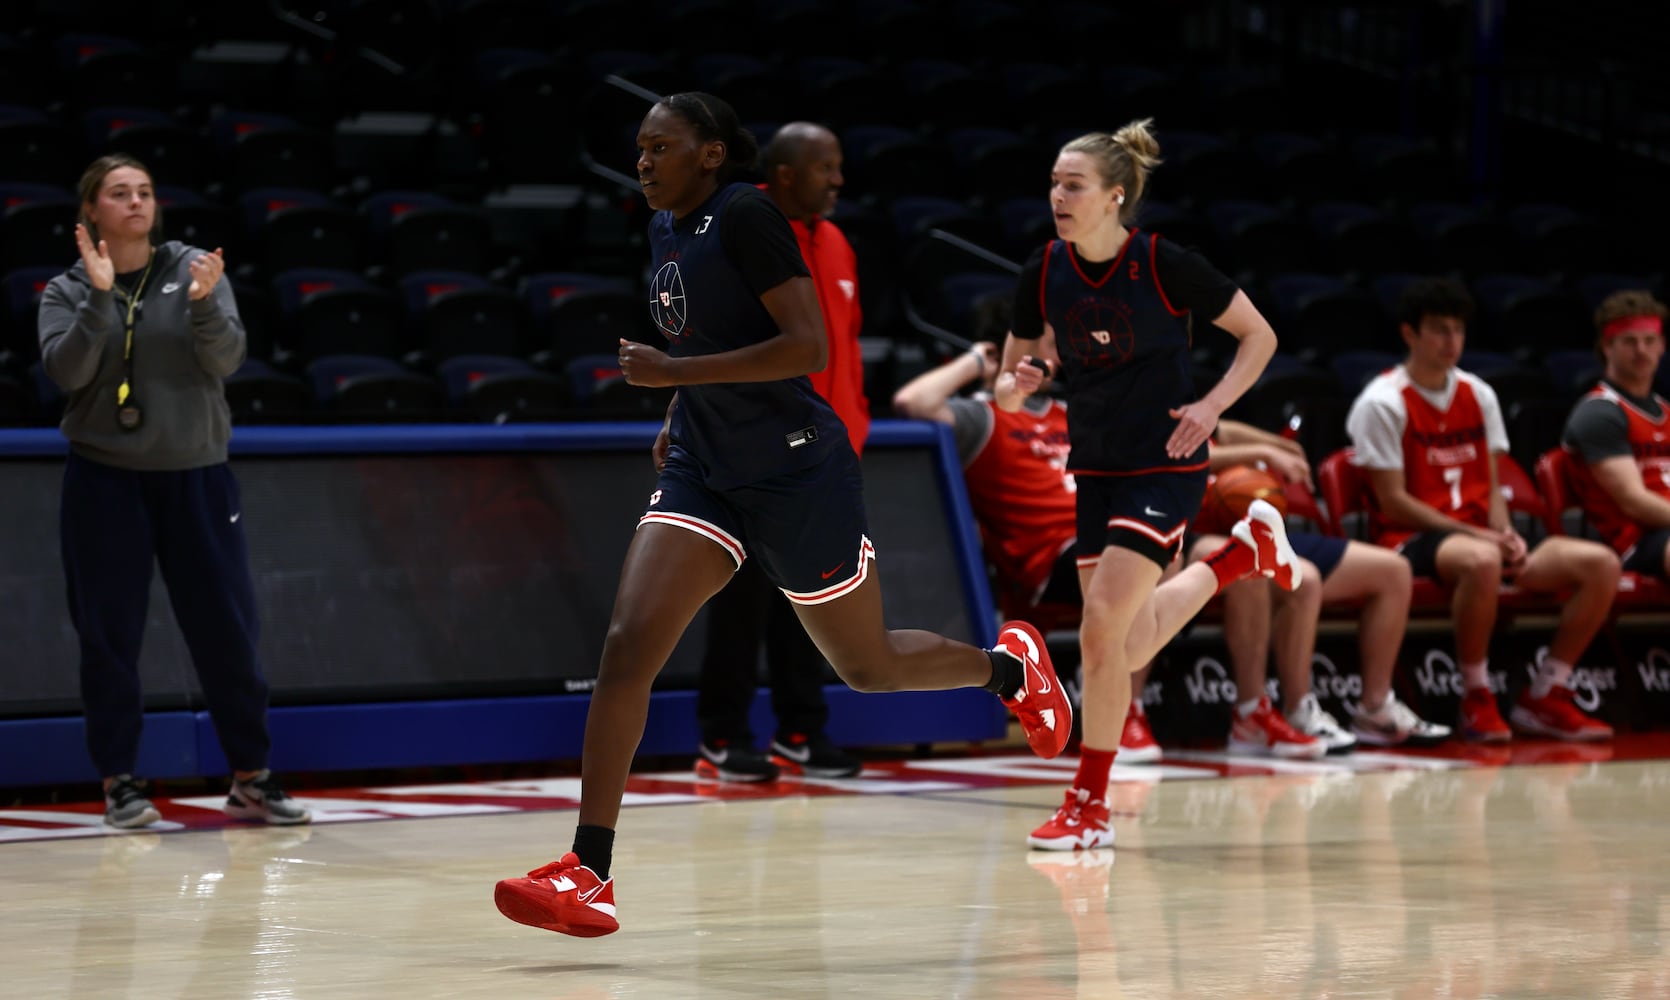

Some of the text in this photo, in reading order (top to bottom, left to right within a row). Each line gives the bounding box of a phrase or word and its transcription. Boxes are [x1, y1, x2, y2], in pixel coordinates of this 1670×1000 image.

[1128, 260, 1140, 281] 2
[806, 431, 813, 439] L
[1441, 465, 1464, 511] 7
